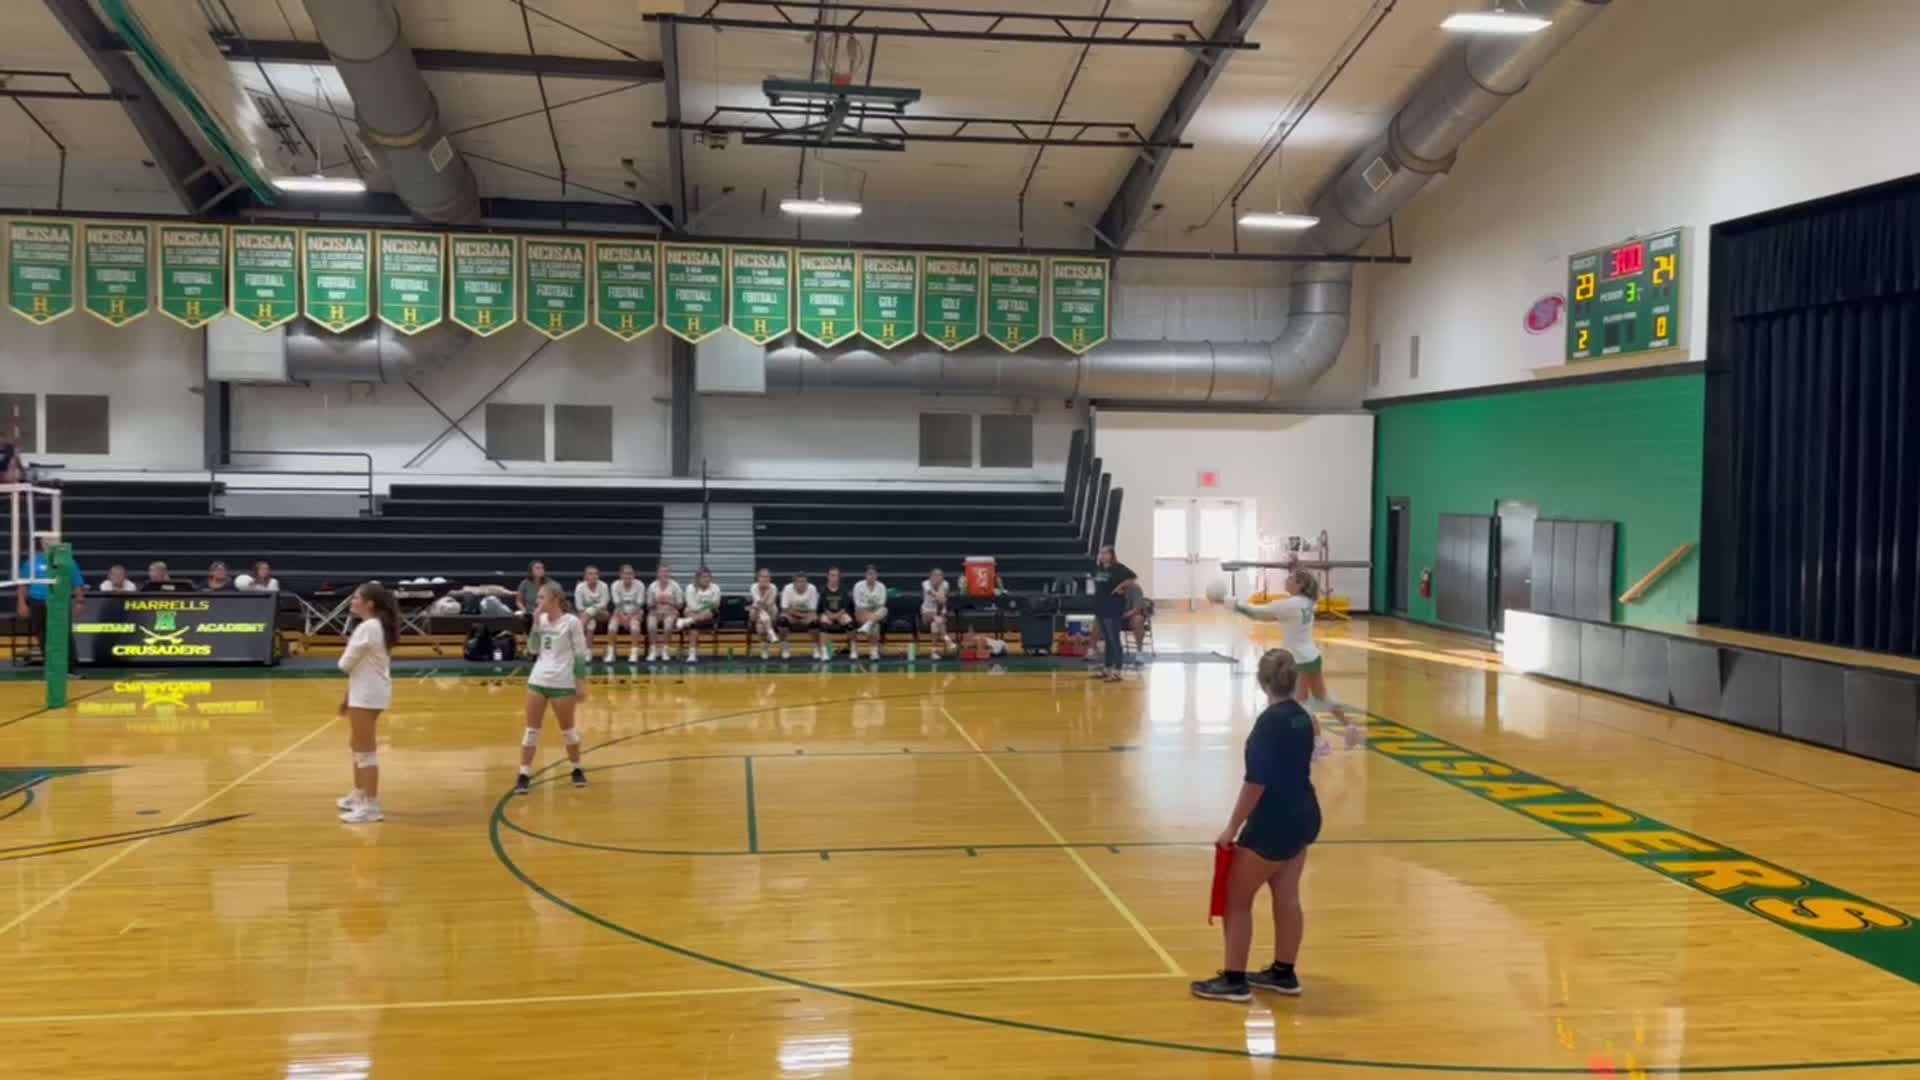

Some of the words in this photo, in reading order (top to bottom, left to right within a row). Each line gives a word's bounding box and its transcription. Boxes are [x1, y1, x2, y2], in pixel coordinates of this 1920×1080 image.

[1652, 255, 1675, 285] 24
[1626, 282, 1636, 303] 3
[34, 296, 47, 312] H
[112, 299, 124, 314] H
[187, 300, 199, 316] H
[878, 296, 898, 308] GOLF
[942, 297, 960, 309] GOLF
[259, 303, 271, 318] H
[331, 306, 343, 319] H
[404, 308, 416, 323] H
[478, 310, 491, 324] H
[550, 312, 562, 327] H
[621, 314, 633, 329] H
[687, 317, 699, 331] H
[755, 320, 767, 335] H
[821, 321, 833, 336] H
[883, 323, 894, 337] H
[945, 325, 956, 338] H
[1008, 326, 1019, 339] H
[1072, 327, 1084, 341] H
[1578, 329, 1589, 350] 2
[124, 600, 210, 611] HARRELLS
[196, 623, 267, 633] ACADEMY
[112, 645, 212, 656] CRUSADERS
